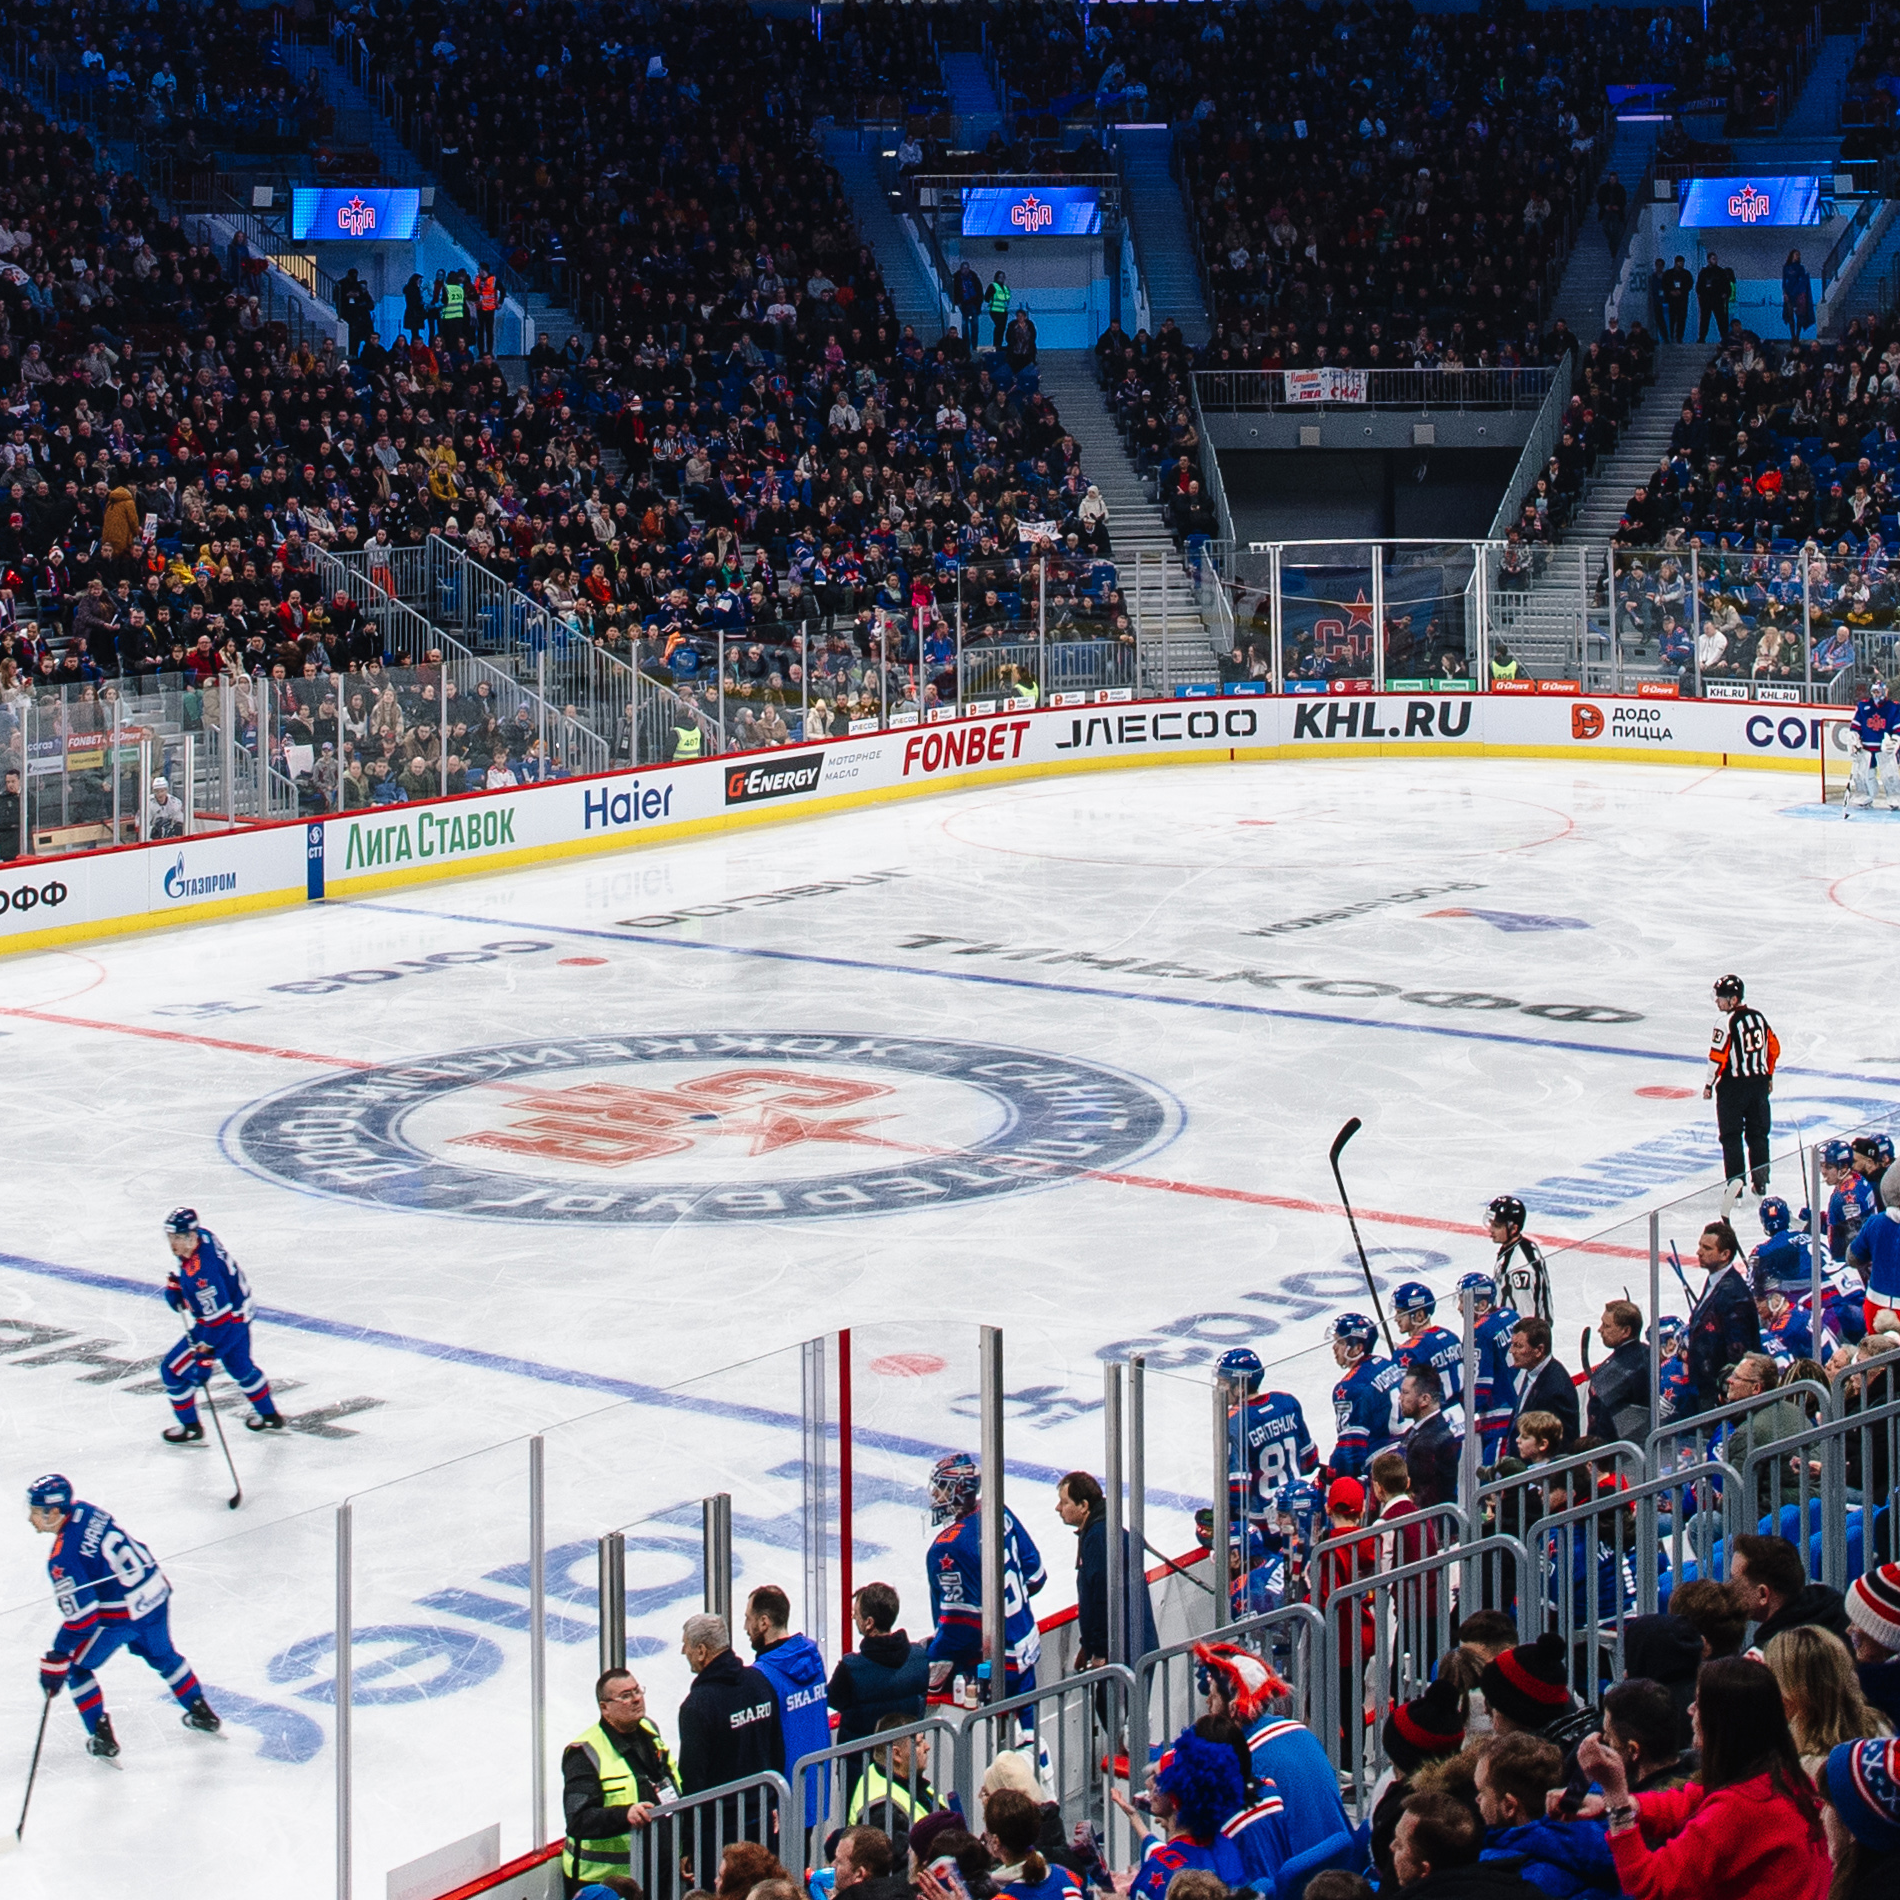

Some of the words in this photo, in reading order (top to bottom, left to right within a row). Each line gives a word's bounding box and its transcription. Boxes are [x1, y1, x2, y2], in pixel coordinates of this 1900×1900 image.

[1293, 700, 1472, 740] KHL.RU
[1613, 707, 1662, 723] ДОДО
[902, 720, 1031, 777] FONBET
[1613, 725, 1674, 742] ПИЦЦА
[828, 748, 883, 768] МОТОРНОЕ
[824, 767, 860, 782] МАСЛО
[583, 779, 674, 829] Haier
[185, 869, 238, 899] ГАЗПРОМ
[1743, 1029, 1764, 1051] 13
[1512, 1271, 1529, 1289] 87
[1248, 1412, 1298, 1449] GRITSYUK
[1258, 1436, 1301, 1500] 81
[729, 1700, 772, 1730] SKA.RU
